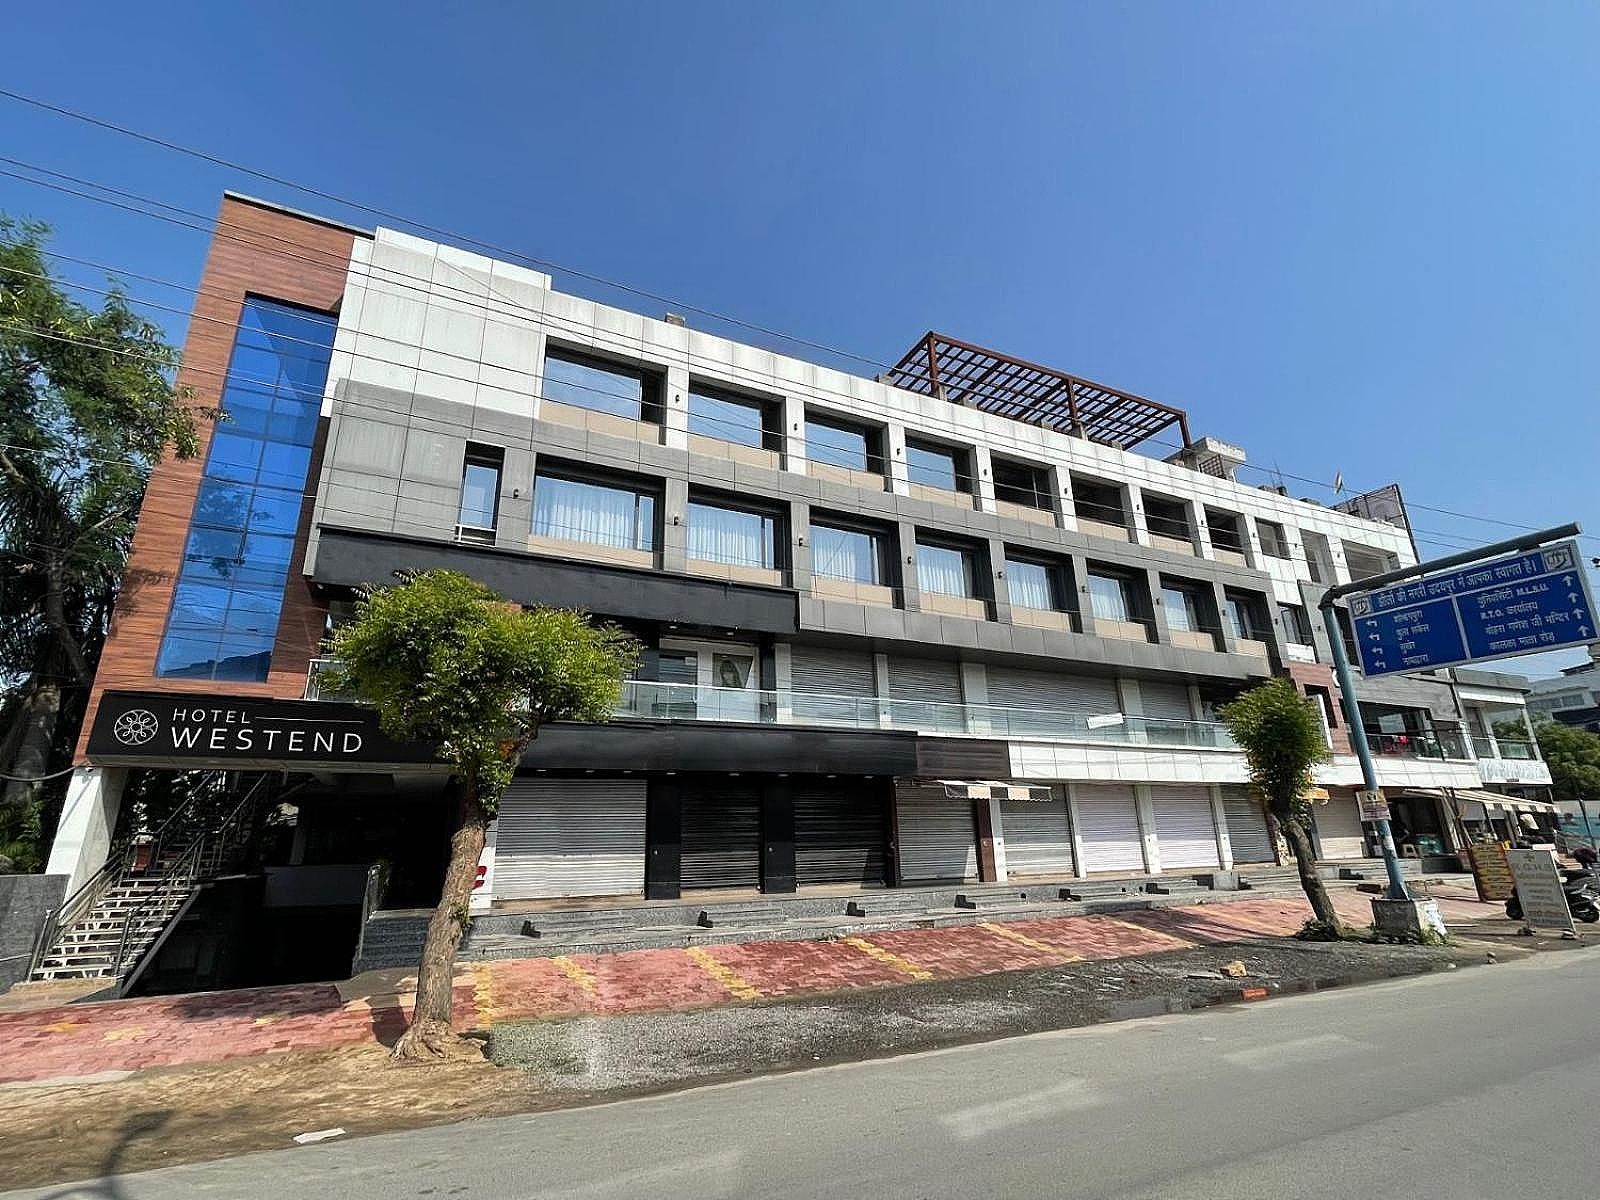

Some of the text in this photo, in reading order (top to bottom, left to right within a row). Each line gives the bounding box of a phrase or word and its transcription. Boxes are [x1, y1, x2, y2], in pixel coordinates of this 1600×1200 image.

[1428, 579, 1456, 595] उदयपुर
[1466, 569, 1493, 587] आपका
[1494, 563, 1523, 579] स्वागत
[172, 708, 251, 725] HOTEL
[170, 726, 363, 754] WESTEND
